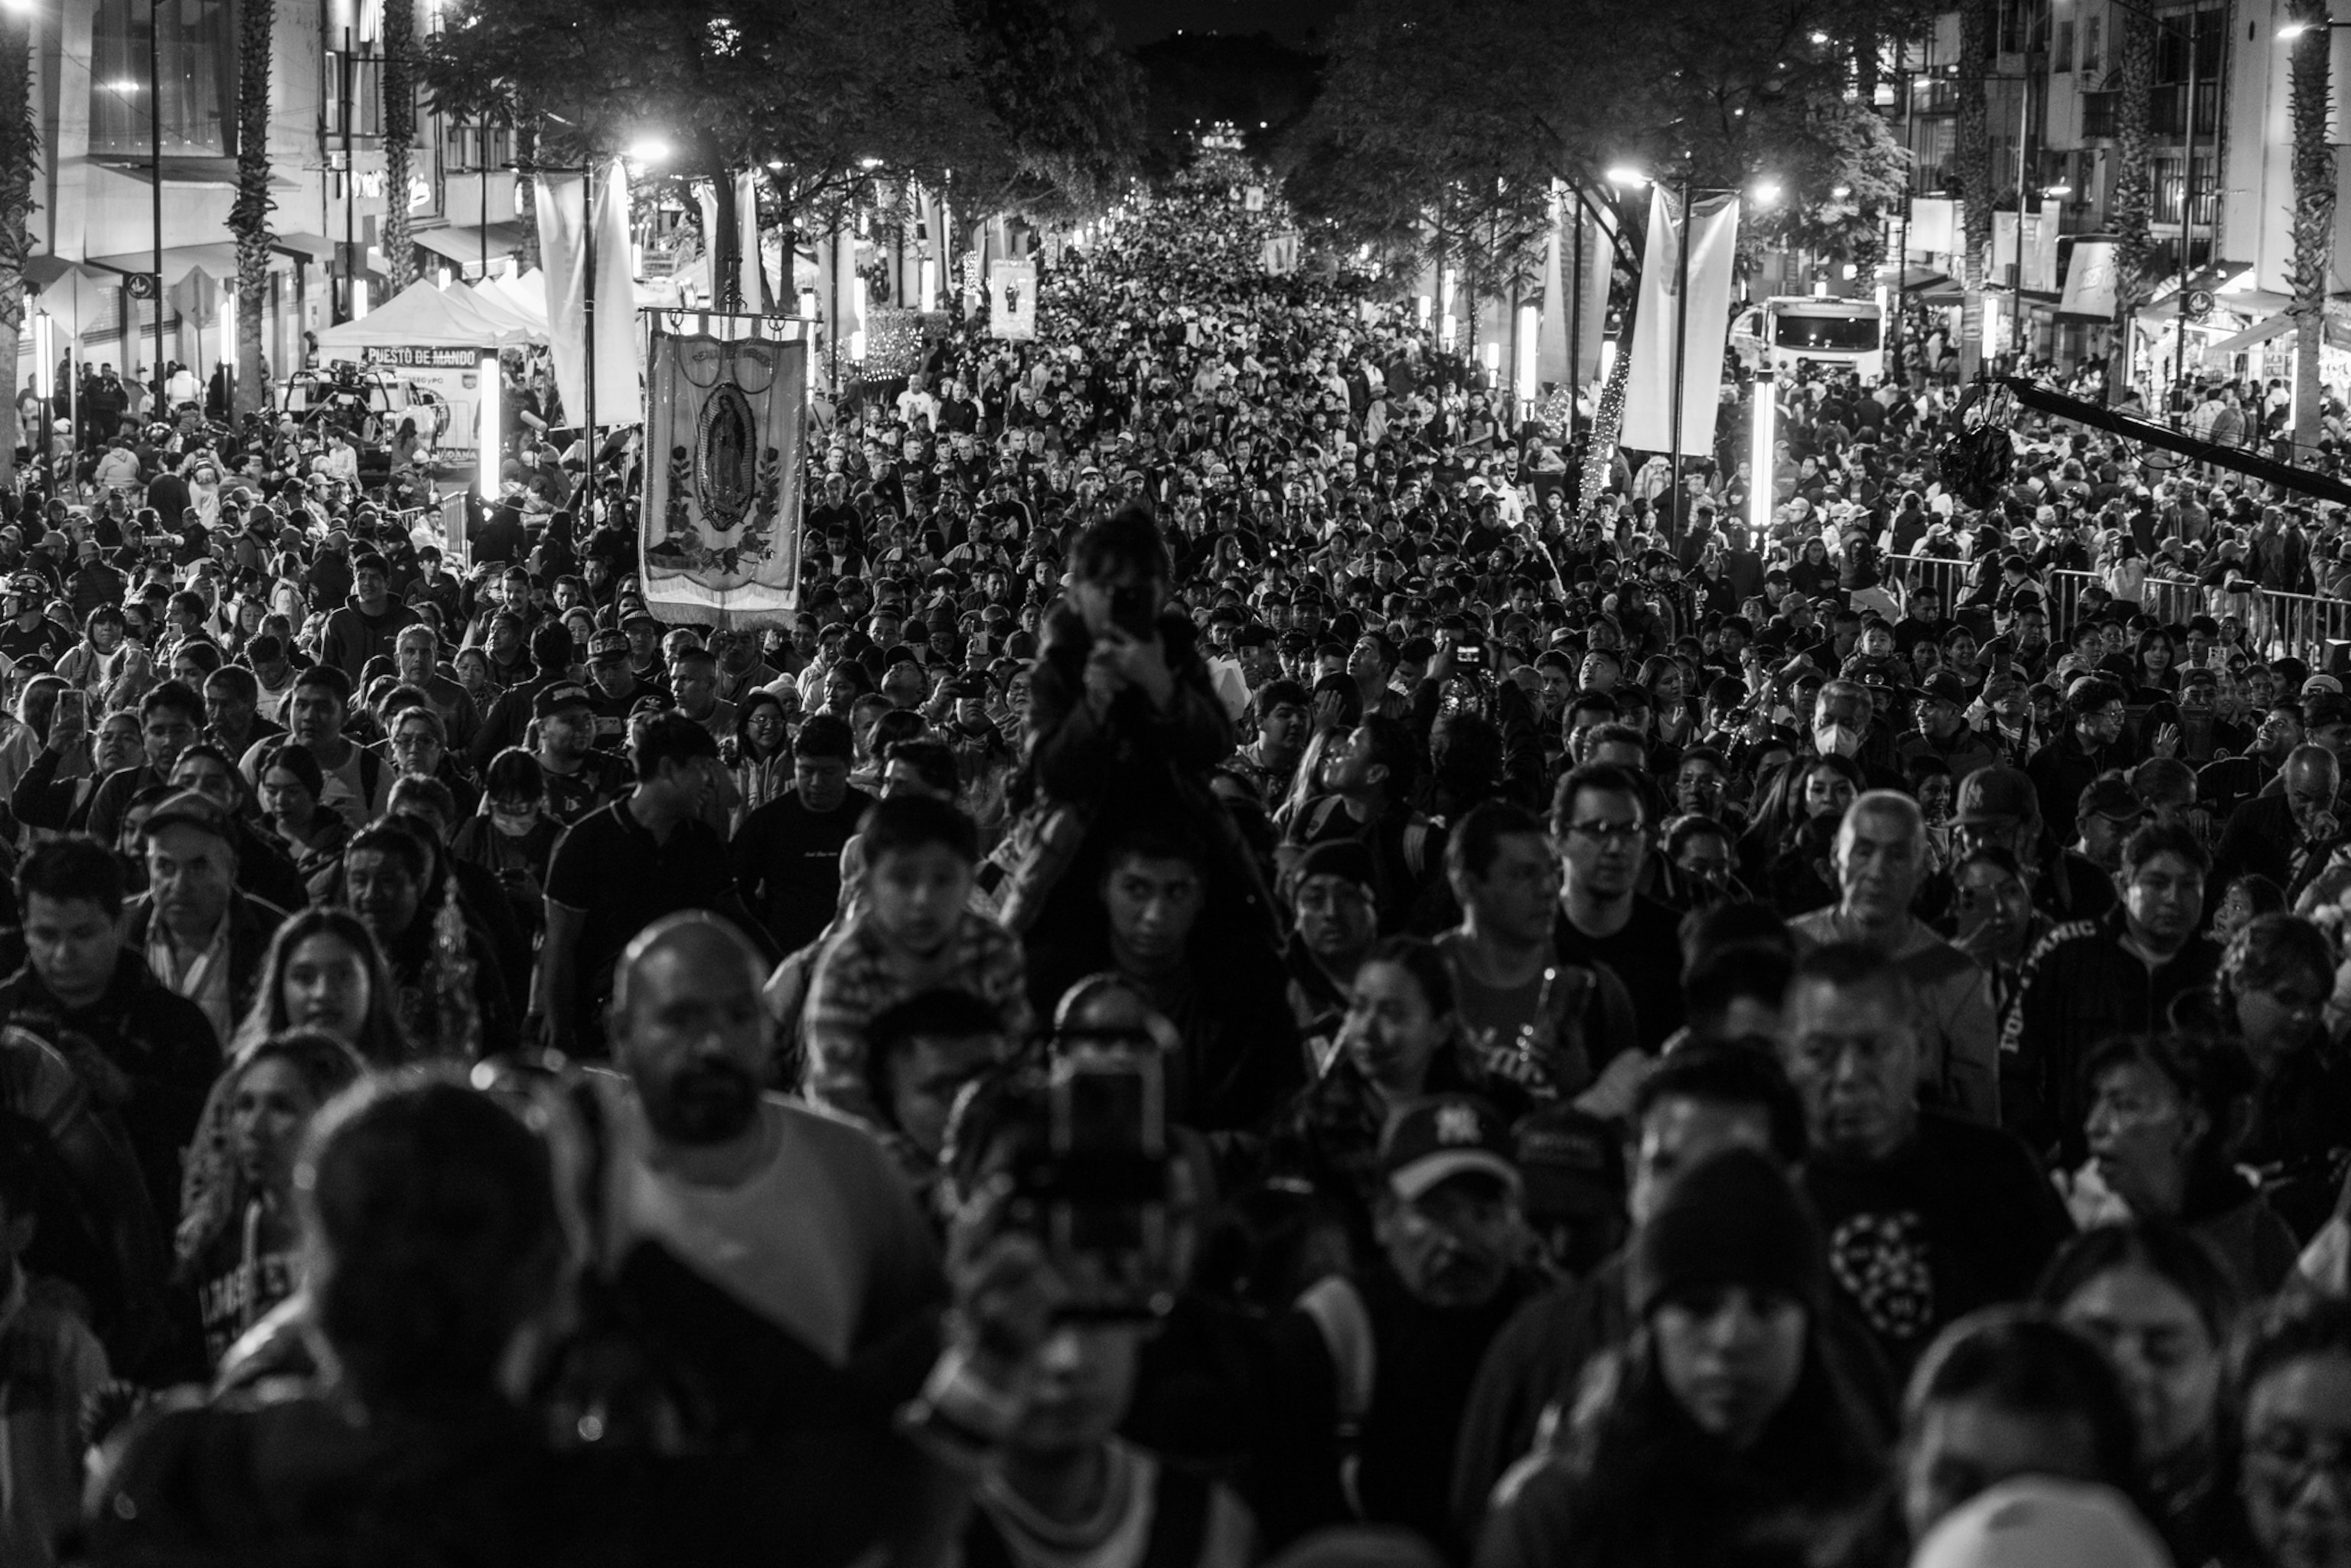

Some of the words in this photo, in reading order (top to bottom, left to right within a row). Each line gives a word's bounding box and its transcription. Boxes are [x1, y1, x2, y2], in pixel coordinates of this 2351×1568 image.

[368, 347, 413, 364] PUESTO
[415, 350, 431, 365] DE
[432, 350, 475, 366] MANDO
